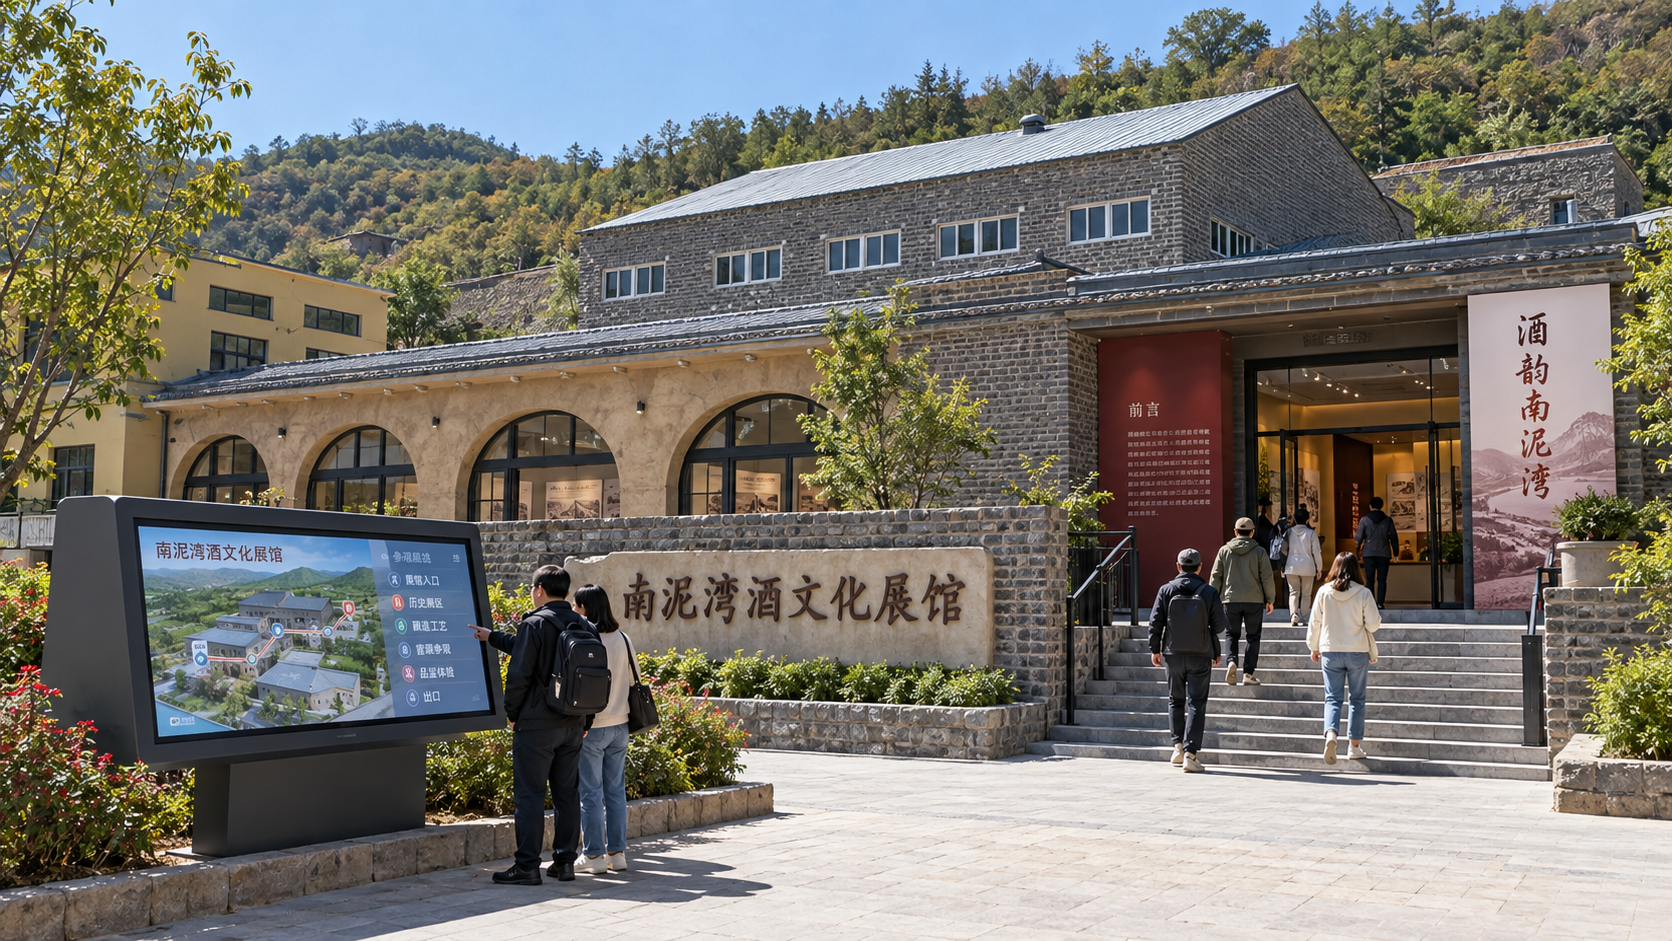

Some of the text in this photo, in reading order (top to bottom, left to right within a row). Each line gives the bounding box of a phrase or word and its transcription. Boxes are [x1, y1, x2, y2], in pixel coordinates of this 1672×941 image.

[1128, 401, 1160, 418] 前言
[1515, 312, 1552, 500] 酒韵南泥湾
[155, 540, 283, 563] 南泥湾酒文化展馆
[623, 572, 966, 626] 南泥湾酒文化展馆
[423, 690, 441, 702] 出口
